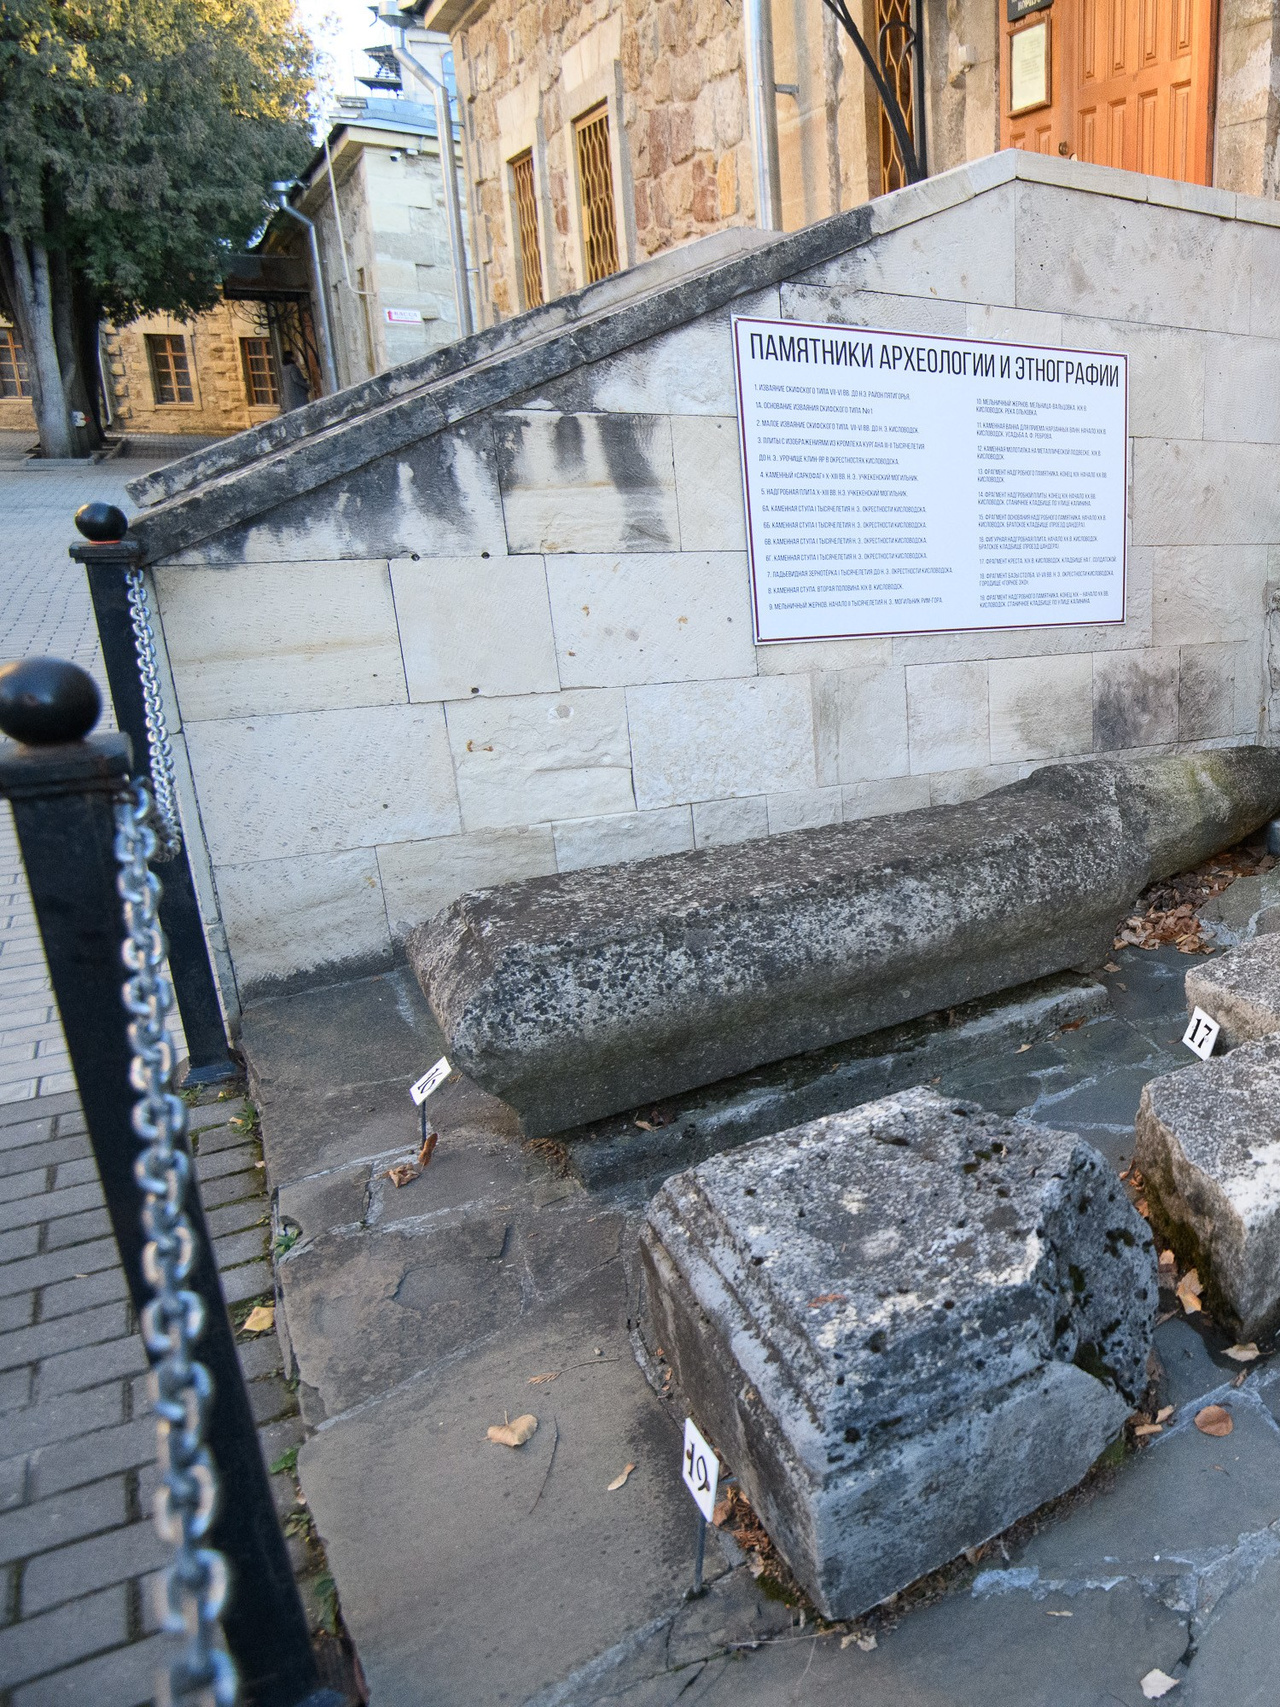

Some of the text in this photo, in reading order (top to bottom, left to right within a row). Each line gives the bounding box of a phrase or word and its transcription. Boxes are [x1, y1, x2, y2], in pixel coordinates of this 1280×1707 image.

[750, 333, 1119, 388] ПАМЯТНИКИ АРХЕОЛОГИИ И ЭТНОГРАФИИ
[1188, 1018, 1213, 1049] 17
[417, 1067, 443, 1094] 16
[688, 1441, 709, 1491] 19
